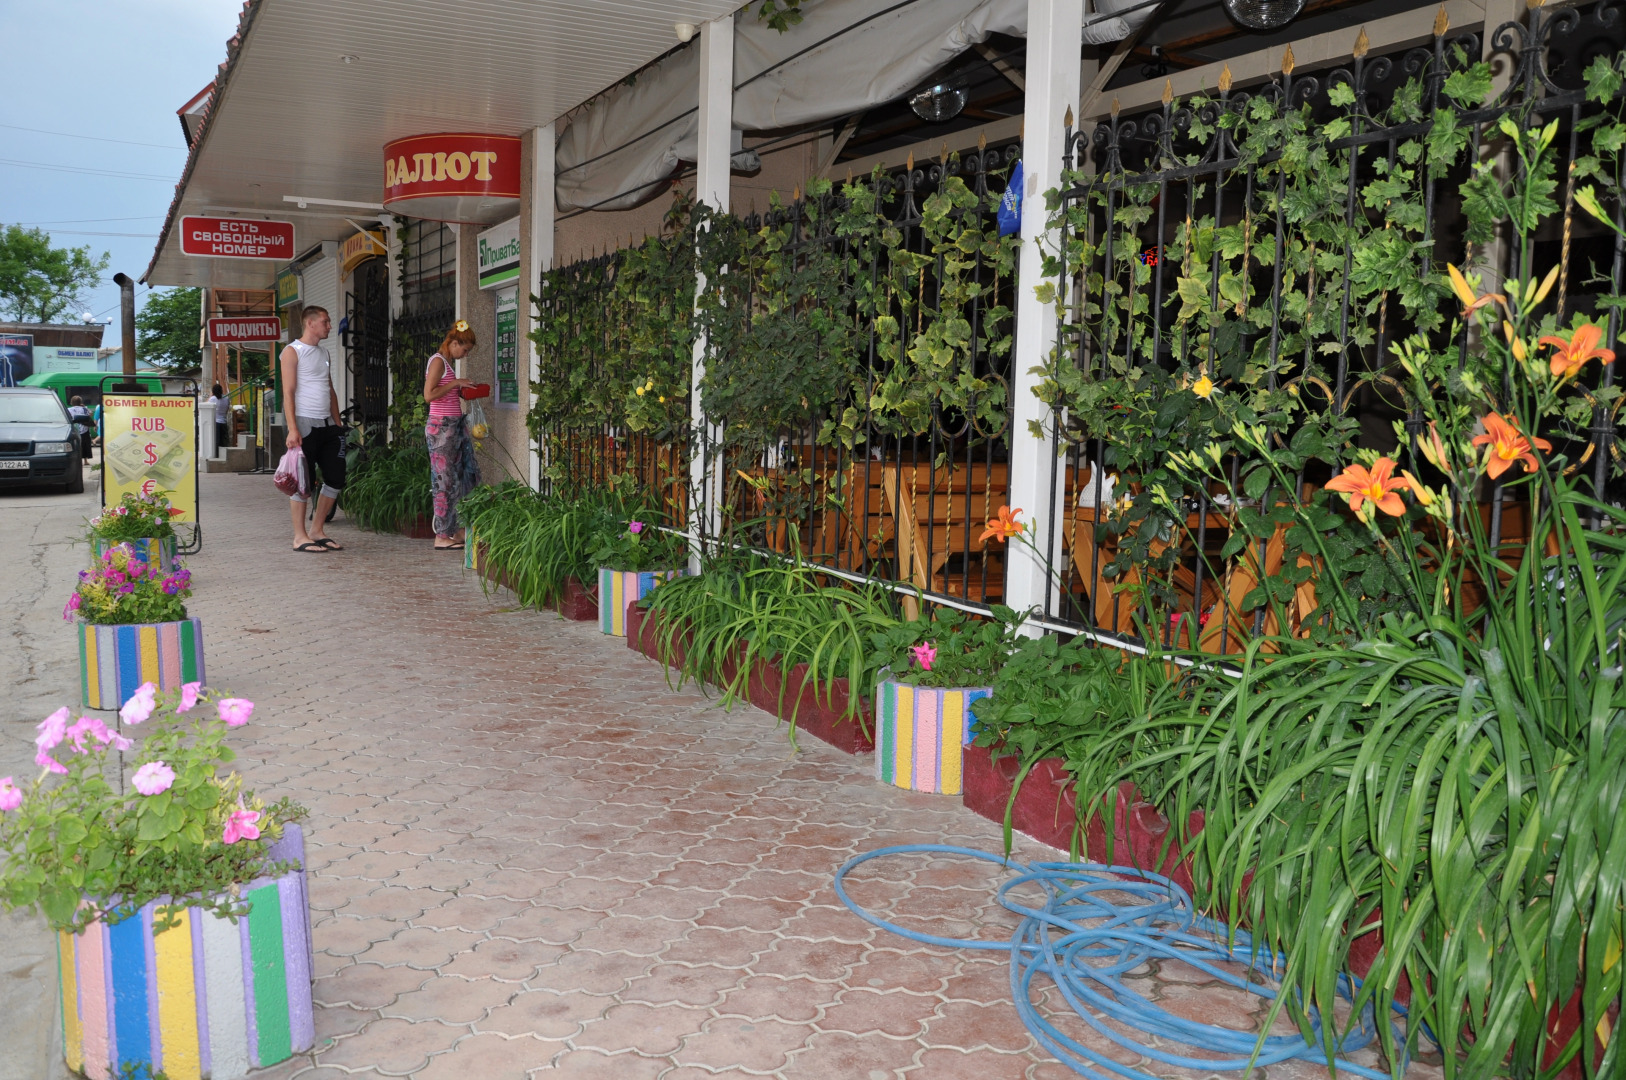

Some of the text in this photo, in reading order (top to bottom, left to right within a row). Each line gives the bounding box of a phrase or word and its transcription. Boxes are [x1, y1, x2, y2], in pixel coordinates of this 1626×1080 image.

[386, 151, 497, 188] ВАЛЮТ
[220, 222, 258, 233] ЕСТЬ
[192, 231, 285, 246] СВОБОДНЫЙ
[212, 243, 267, 256] НОМЕР
[487, 238, 520, 267] ПриватБа
[215, 322, 277, 339] ПРОДУКТЫ
[105, 399, 193, 408] ОБМЕН ВАЛЮТ
[131, 417, 166, 432] RUB
[143, 442, 158, 466] $
